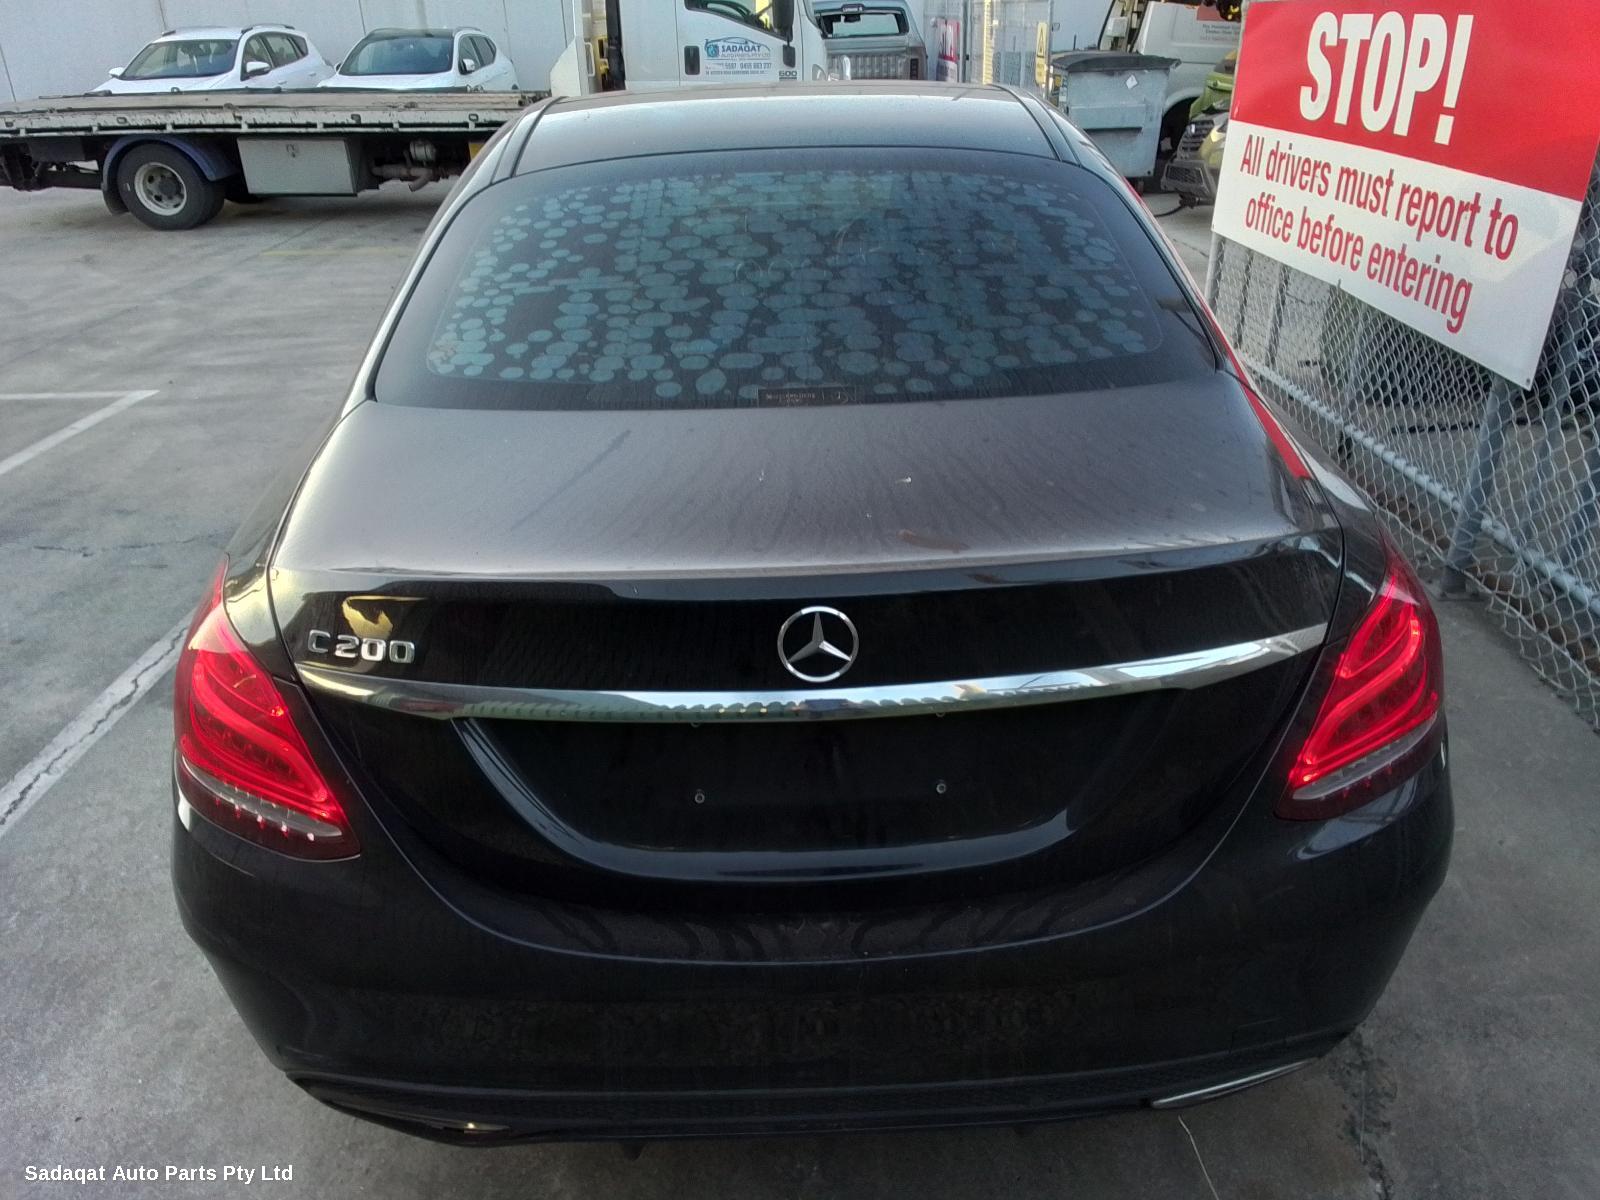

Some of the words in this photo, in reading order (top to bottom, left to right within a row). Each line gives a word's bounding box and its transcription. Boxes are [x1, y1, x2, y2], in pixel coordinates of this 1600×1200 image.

[721, 45, 761, 53] SADAQAT
[1300, 11, 1474, 146] STOP!
[1240, 135, 1265, 176] All
[1265, 142, 1331, 197] drivers
[1334, 165, 1395, 217] must
[1395, 182, 1482, 248] report
[1484, 197, 1519, 261] to
[1245, 191, 1294, 243] office
[1297, 206, 1364, 272] before
[1367, 242, 1473, 335] entering
